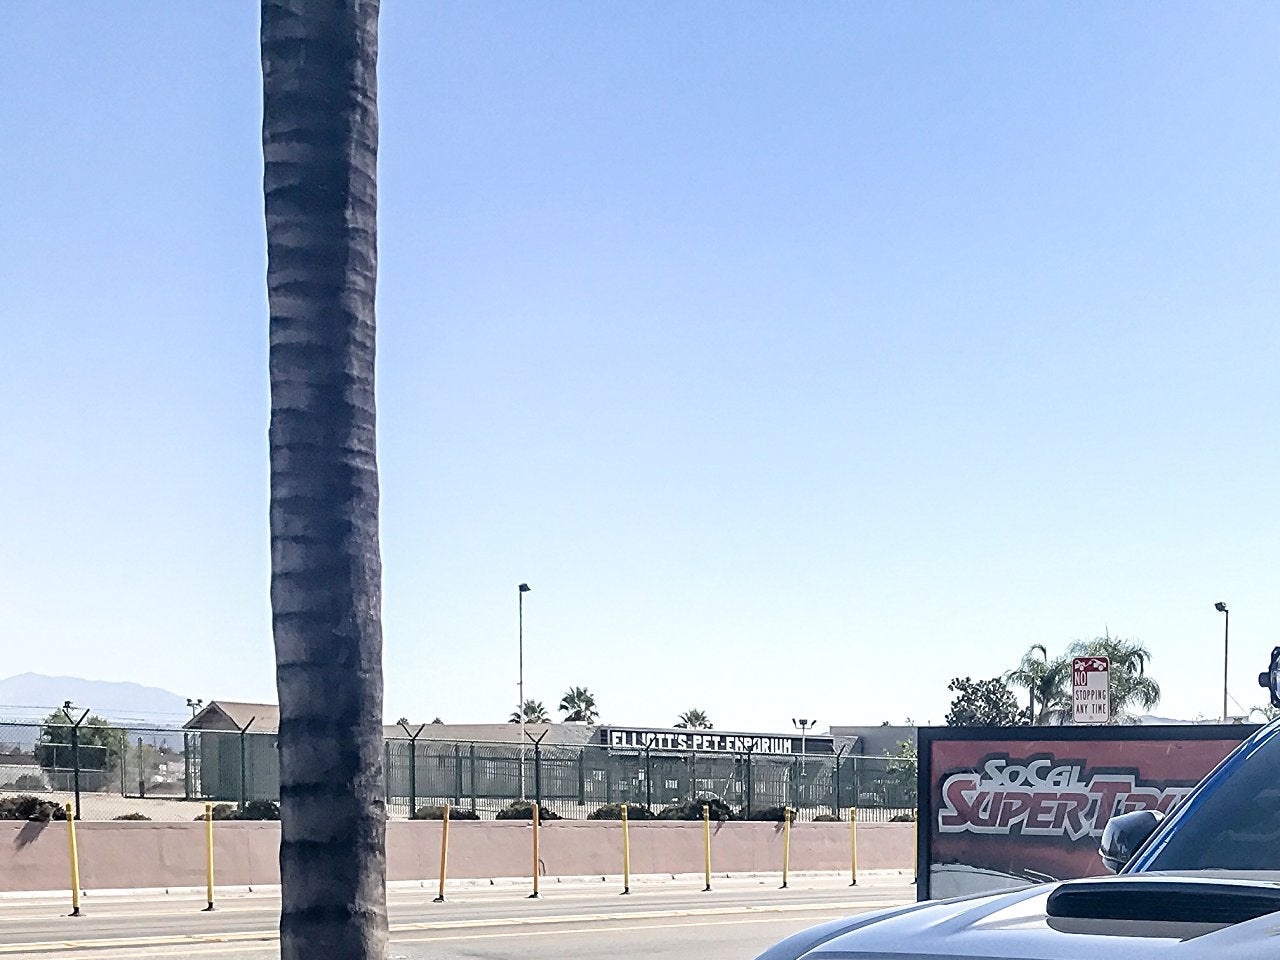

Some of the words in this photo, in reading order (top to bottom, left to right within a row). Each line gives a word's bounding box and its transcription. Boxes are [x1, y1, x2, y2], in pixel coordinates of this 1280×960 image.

[1074, 671, 1087, 686] NO
[1075, 689, 1107, 701] STOPPING
[1075, 703, 1089, 714] ANY
[1091, 703, 1107, 714] TIME
